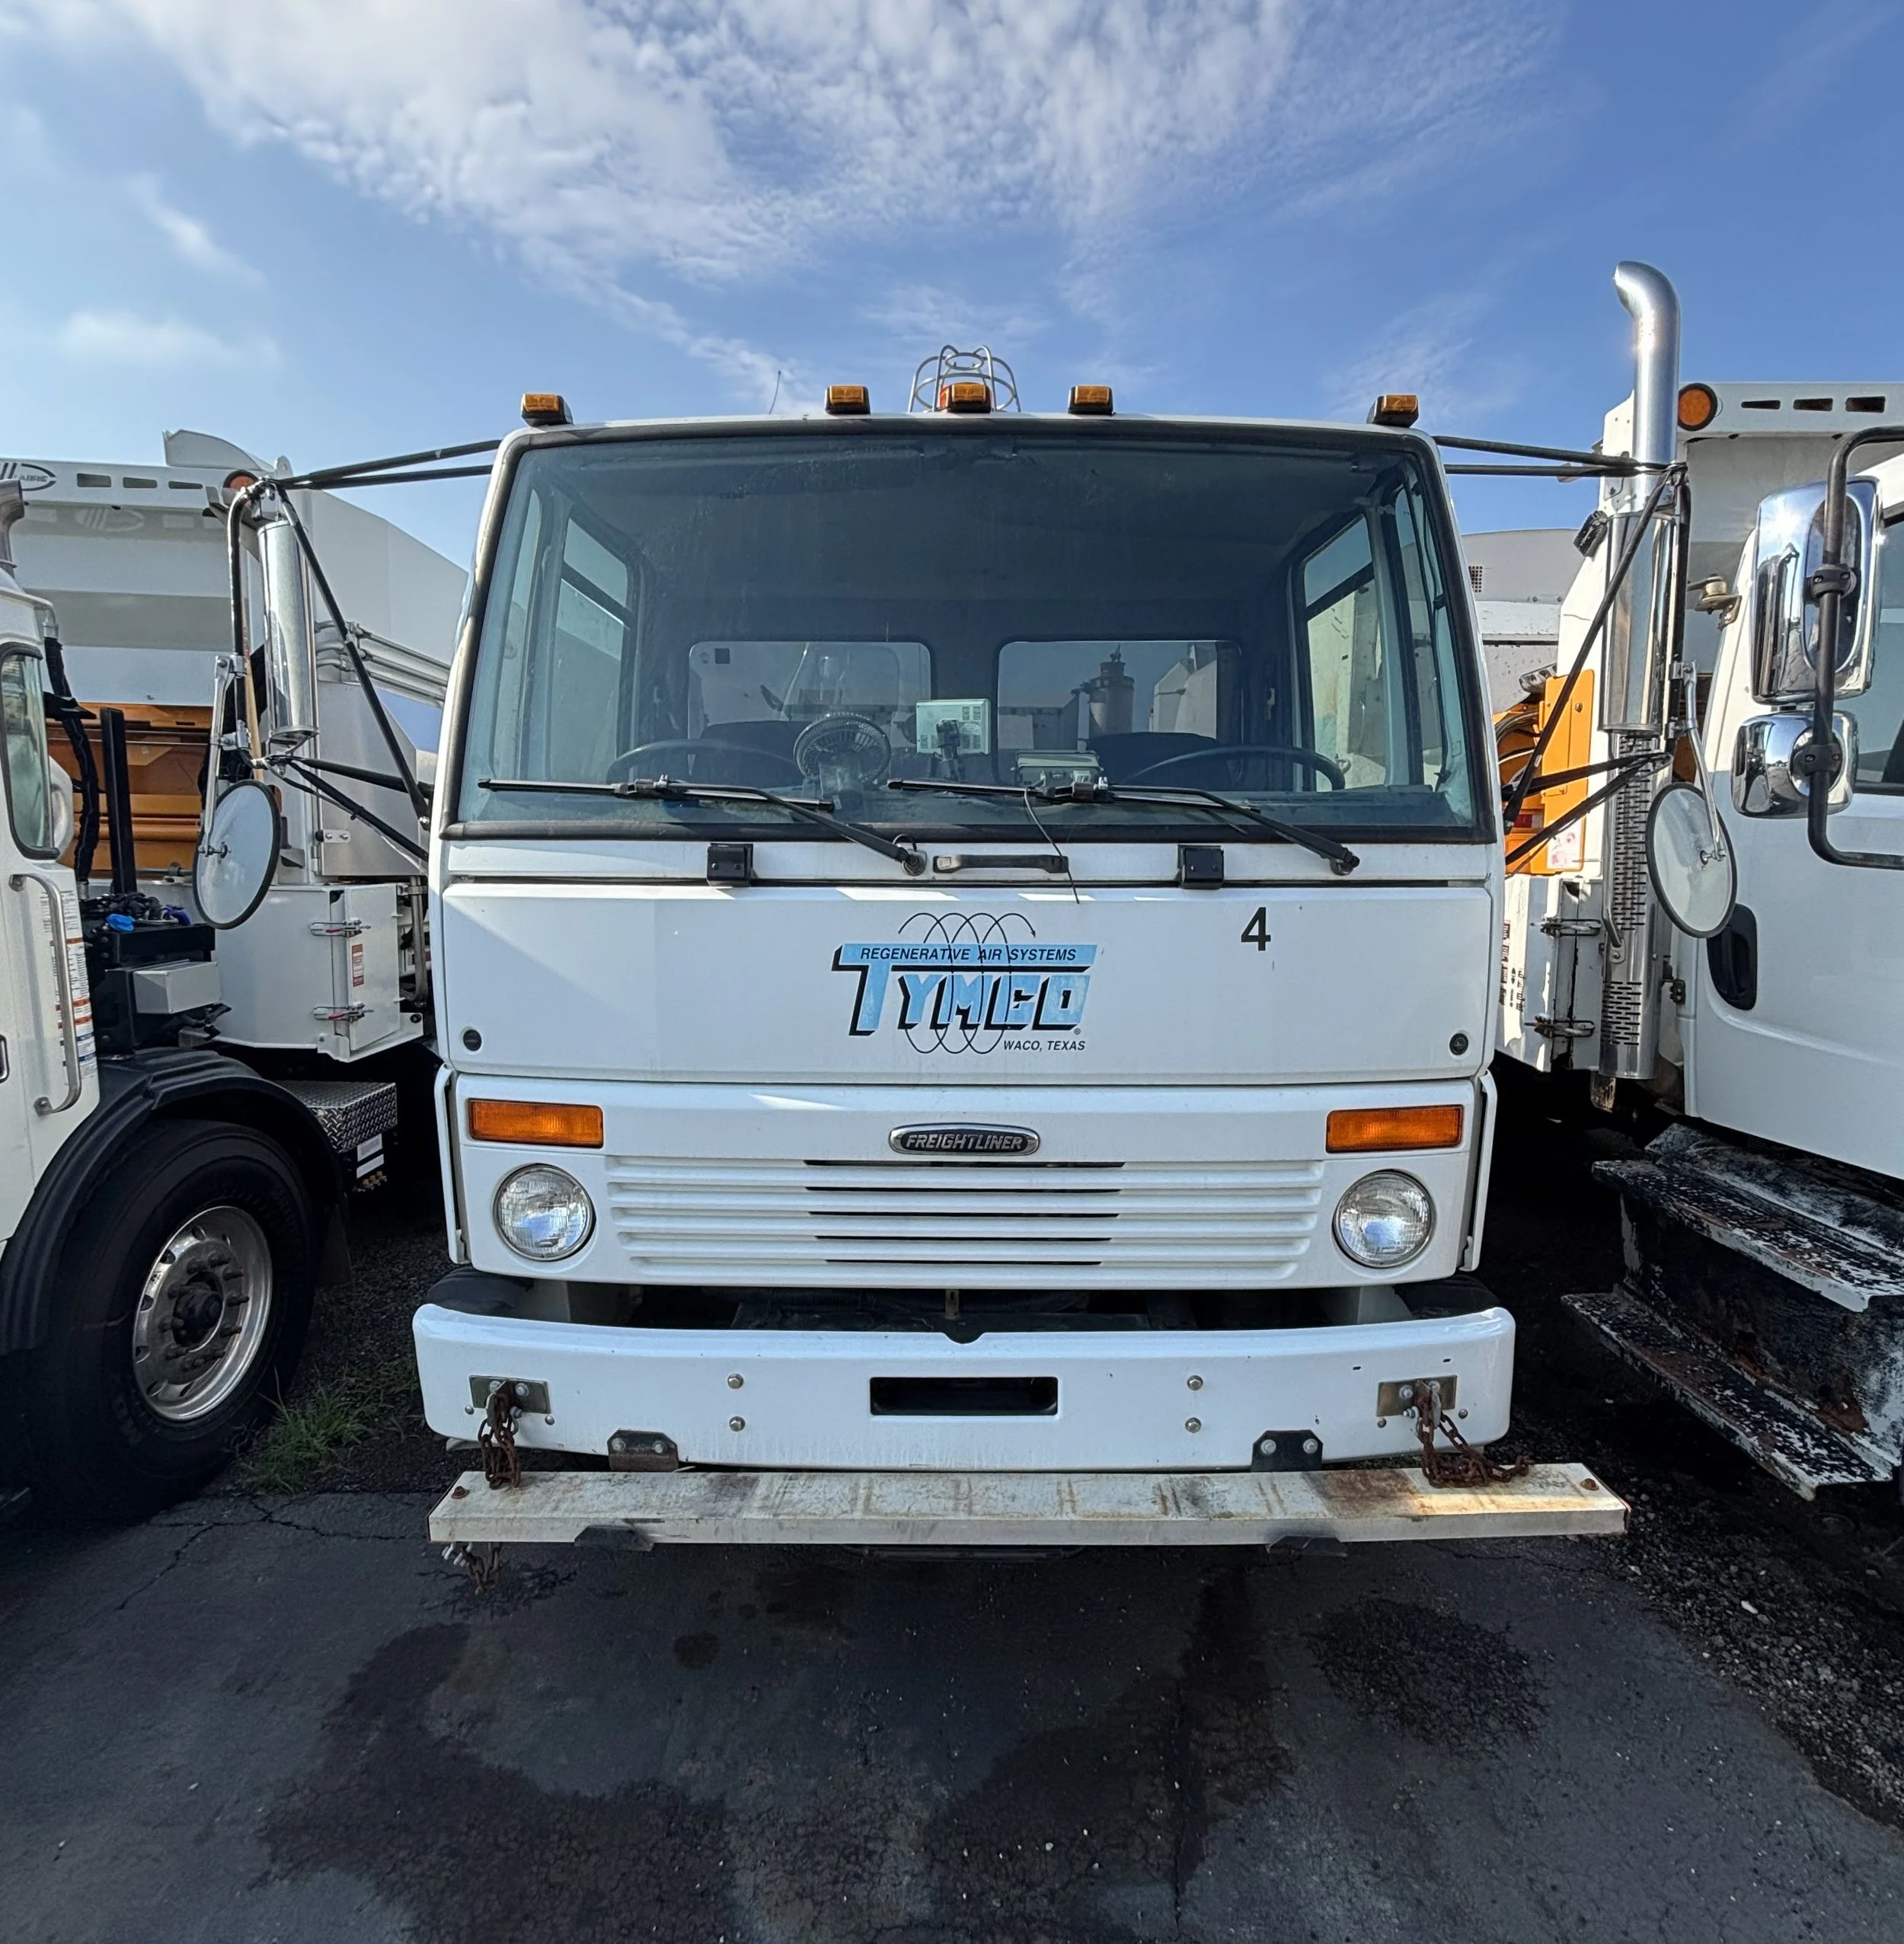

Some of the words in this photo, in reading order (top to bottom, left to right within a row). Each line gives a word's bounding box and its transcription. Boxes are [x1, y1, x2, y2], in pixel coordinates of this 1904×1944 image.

[1241, 906, 1271, 951] 4
[860, 947, 971, 960] REGENERATIVE
[977, 948, 1002, 960] AIR
[1009, 948, 1077, 961] SYSTEMS
[831, 943, 1097, 1036] TYMCO
[1003, 1039, 1043, 1052] WACO,
[1047, 1040, 1086, 1051] TEXAS
[906, 1134, 1024, 1150] FREIGHTLINER
